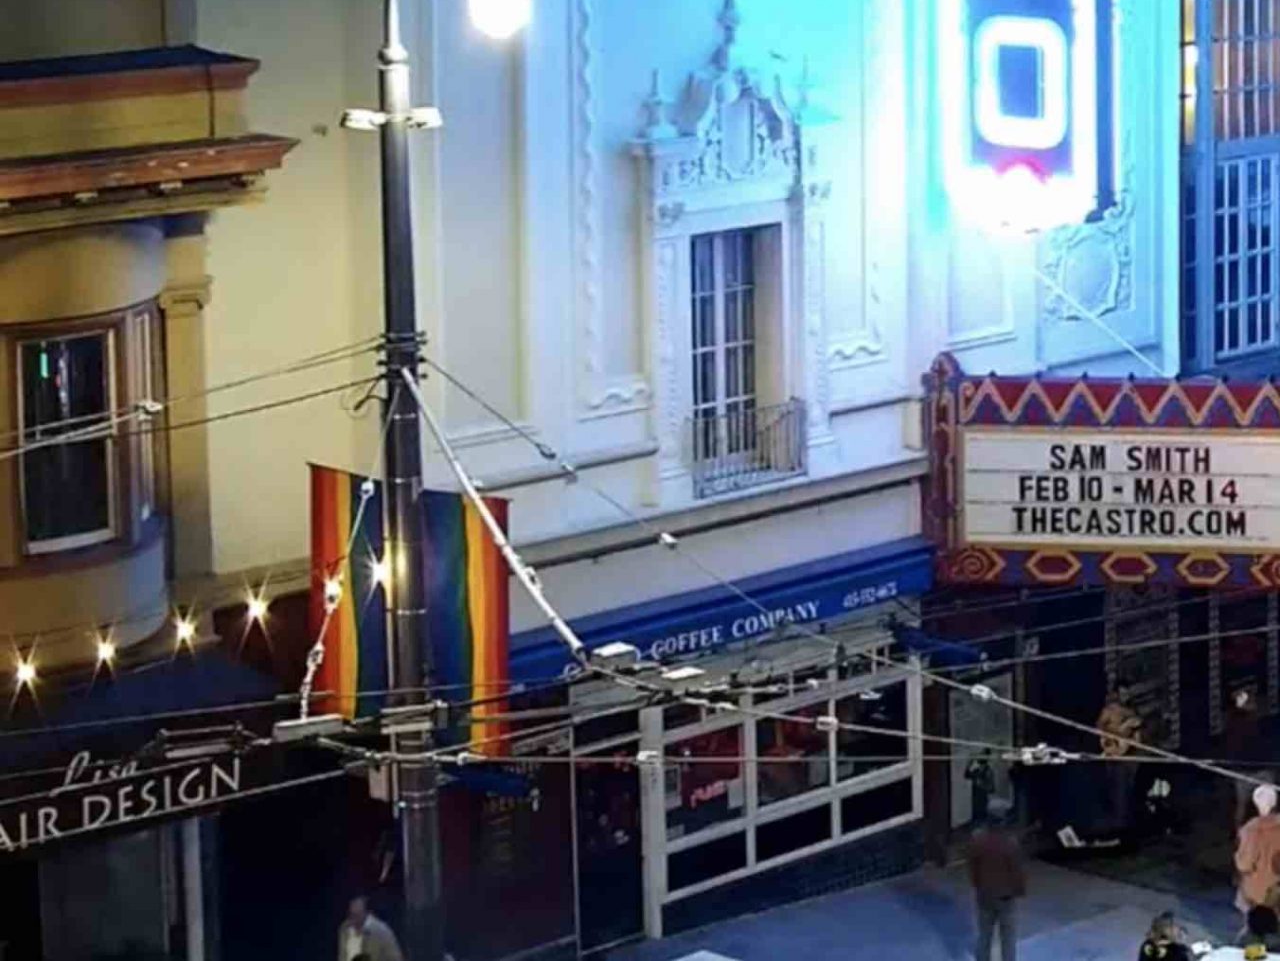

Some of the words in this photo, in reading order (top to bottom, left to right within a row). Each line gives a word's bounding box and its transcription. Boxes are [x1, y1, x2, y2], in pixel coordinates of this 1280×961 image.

[1050, 445, 1106, 471] SAM
[1127, 446, 1211, 473] SMITH
[1018, 477, 1069, 502] FEB
[1078, 476, 1102, 502] 10
[1134, 479, 1194, 505] MAR
[1011, 507, 1247, 536] THECASTRO.COM
[732, 602, 820, 638] COMPANY
[83, 758, 240, 829] DESIGN
